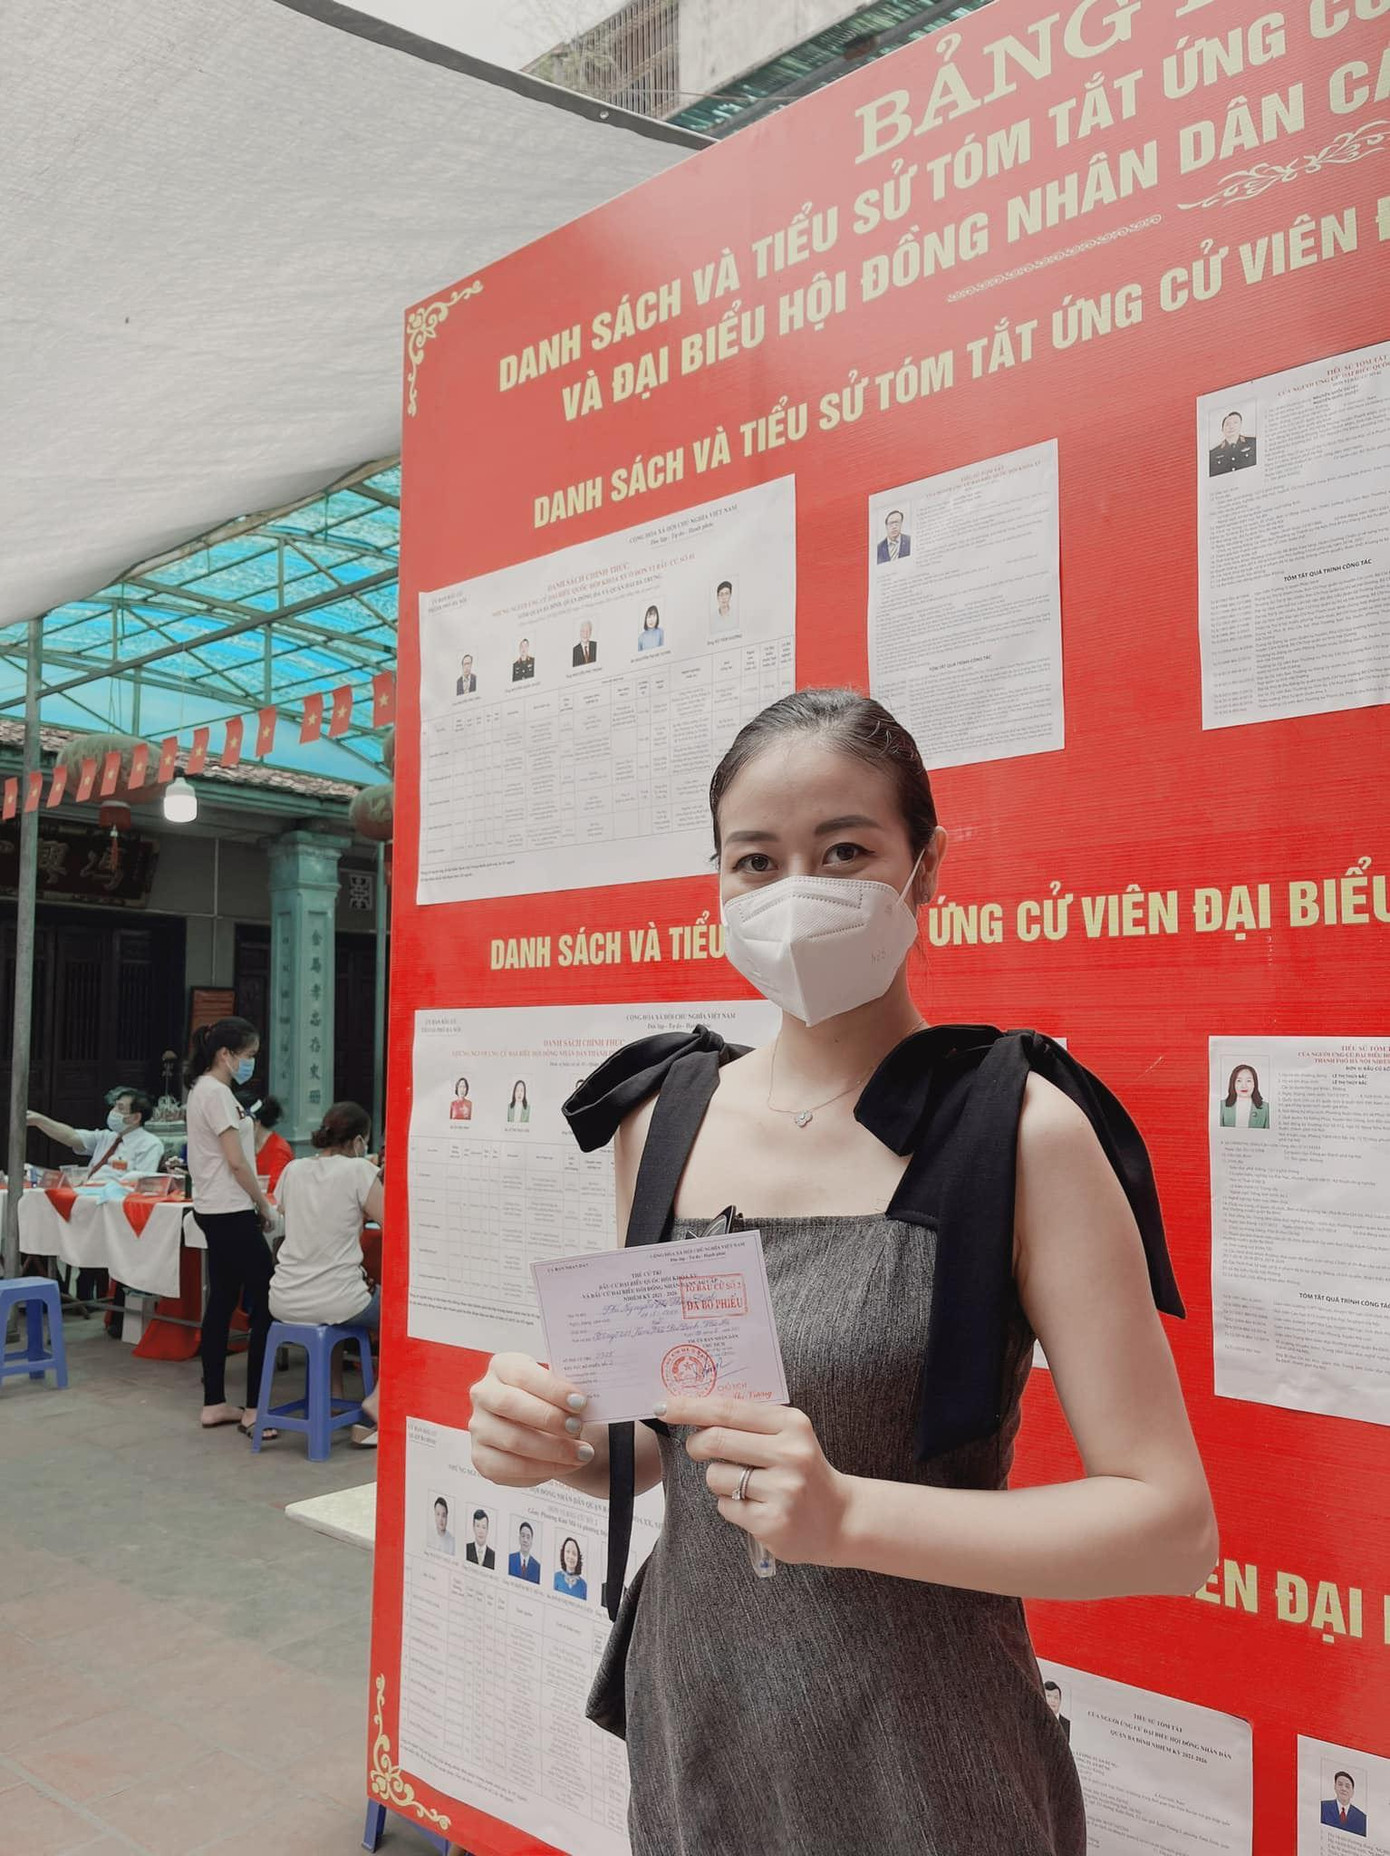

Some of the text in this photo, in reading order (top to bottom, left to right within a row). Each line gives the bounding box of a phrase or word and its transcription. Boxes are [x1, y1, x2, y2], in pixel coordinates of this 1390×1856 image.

[499, 324, 581, 392] DANH
[592, 279, 681, 350] SÁCH
[692, 248, 741, 306] VÀ
[752, 201, 839, 279] TIỂU
[853, 159, 916, 234] SỬ
[927, 118, 1031, 199] TÓM
[1049, 69, 1143, 147] TẮT
[1163, 13, 1286, 99] ỨNG
[855, 0, 1142, 163] BẢNG
[534, 477, 603, 528] DANH
[610, 455, 684, 502] SÁCH
[692, 426, 731, 474] VÀ
[740, 395, 807, 458] TIỂU
[819, 370, 868, 429] SỬ
[879, 350, 953, 411] TÓM
[967, 317, 1038, 379] TẮT
[1051, 283, 1143, 350] ỨNG
[1159, 239, 1228, 312] CỬ
[1239, 206, 1357, 285] VIÊN
[562, 374, 602, 421] VÀ
[612, 353, 669, 400] ĐẠI
[681, 300, 765, 376] BIỂU
[780, 270, 846, 331] HỘI
[861, 225, 989, 302] ĐỒNG
[1007, 140, 1158, 242] NHÂN
[1180, 83, 1305, 175] DÂN
[491, 936, 551, 970] DANH
[558, 926, 621, 967] SÁCH
[629, 921, 661, 962] VÀ
[669, 910, 726, 961] TIỂU
[928, 895, 1003, 946] ỨNG
[1016, 881, 1073, 942] CỬ
[1081, 884, 1179, 939] VIÊN
[1193, 883, 1271, 941] ĐẠI
[1275, 1570, 1363, 1644] ĐẠI
